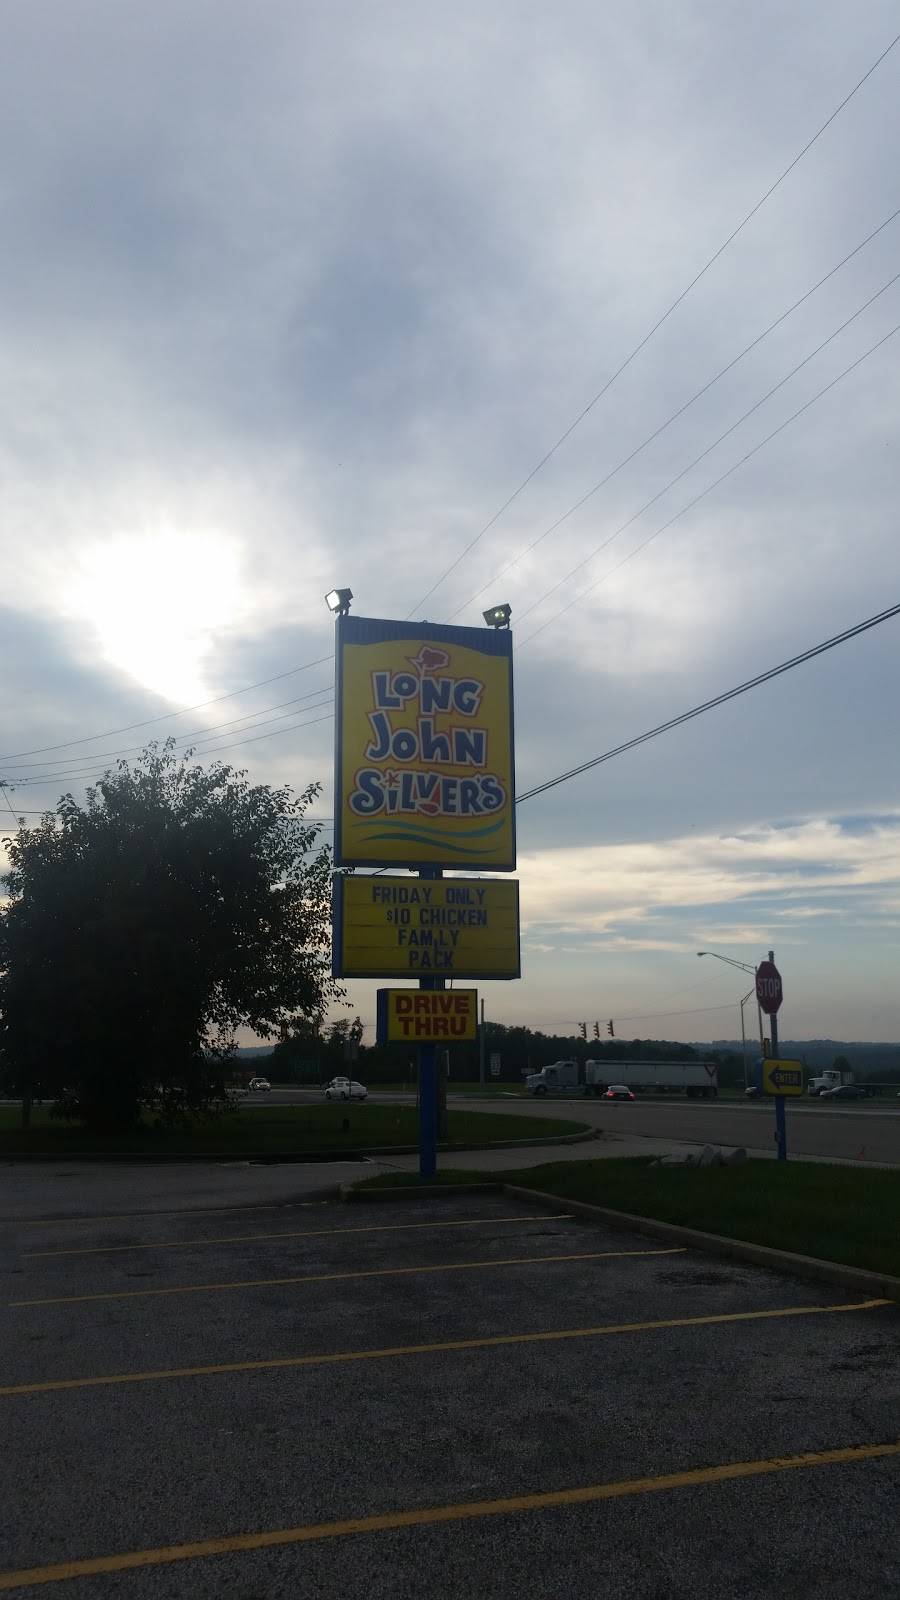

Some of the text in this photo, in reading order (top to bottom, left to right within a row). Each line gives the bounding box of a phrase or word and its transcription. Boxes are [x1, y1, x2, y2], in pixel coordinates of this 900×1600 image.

[372, 886, 485, 905] FRIDAY ONLY
[386, 908, 487, 926] $10 CHICKEN
[408, 951, 455, 968] PACK
[757, 977, 781, 997] STOP
[395, 995, 470, 1014] DRIVE
[398, 1016, 466, 1036] THRU
